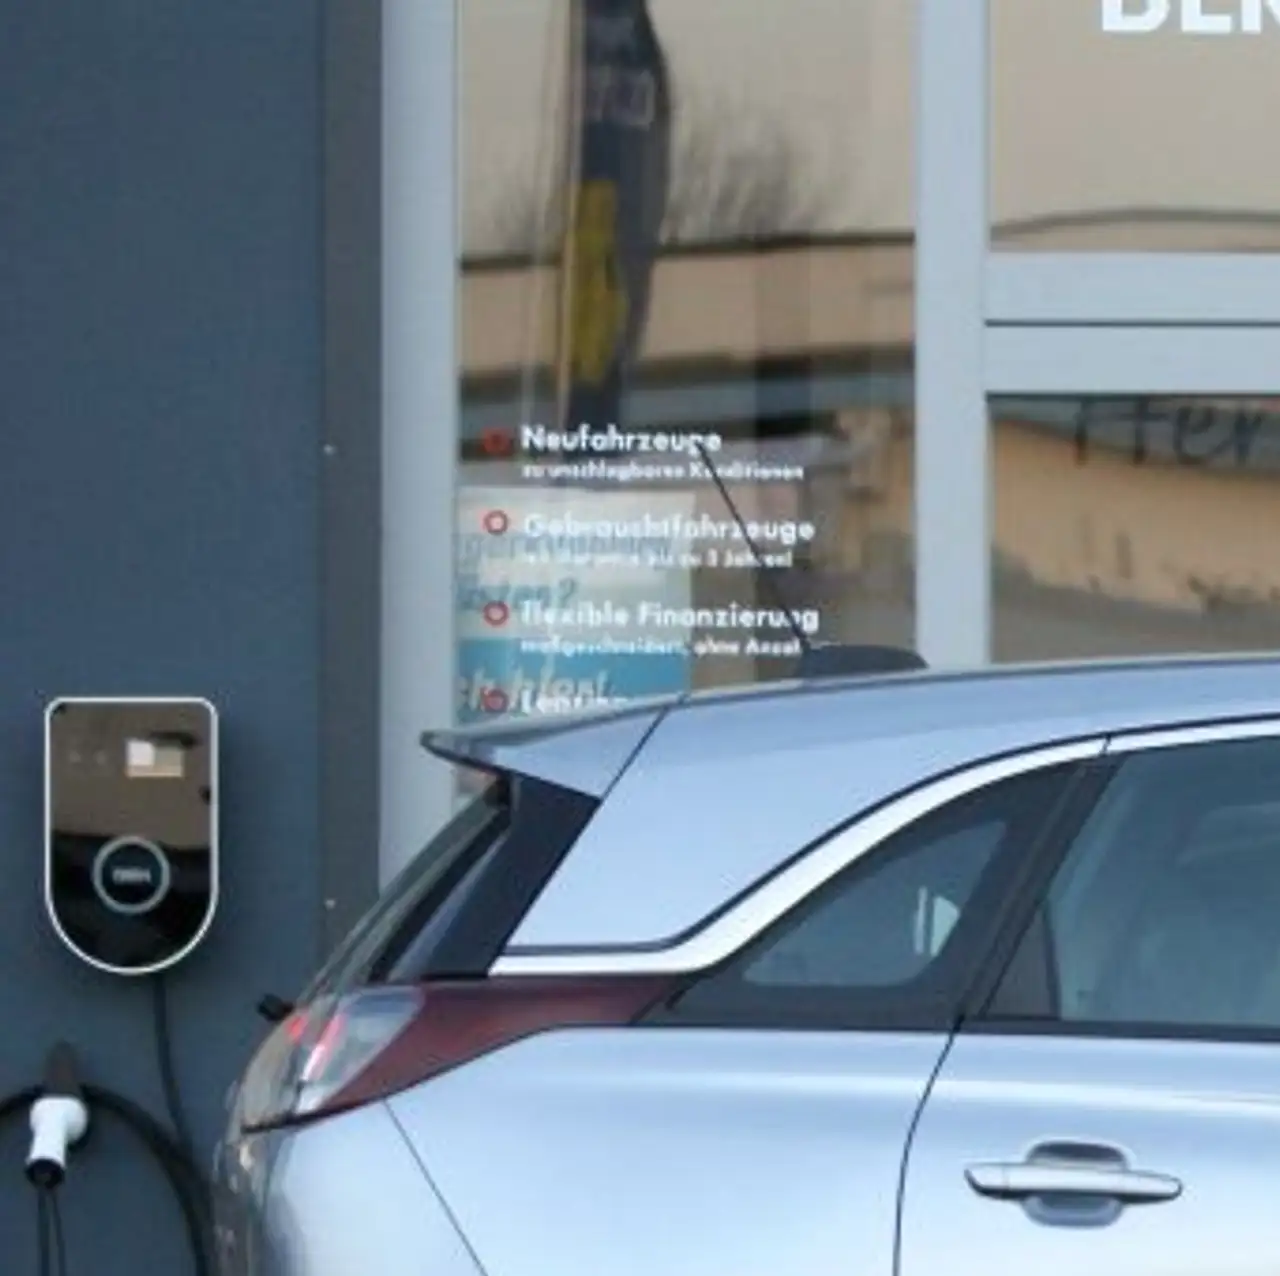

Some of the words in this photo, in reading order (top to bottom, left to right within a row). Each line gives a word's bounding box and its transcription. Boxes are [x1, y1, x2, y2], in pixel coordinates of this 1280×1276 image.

[521, 423, 722, 457] Neufahrzeuge
[525, 511, 816, 545] Gebrauchtfahrzeuge
[638, 600, 819, 634] Finanzierung
